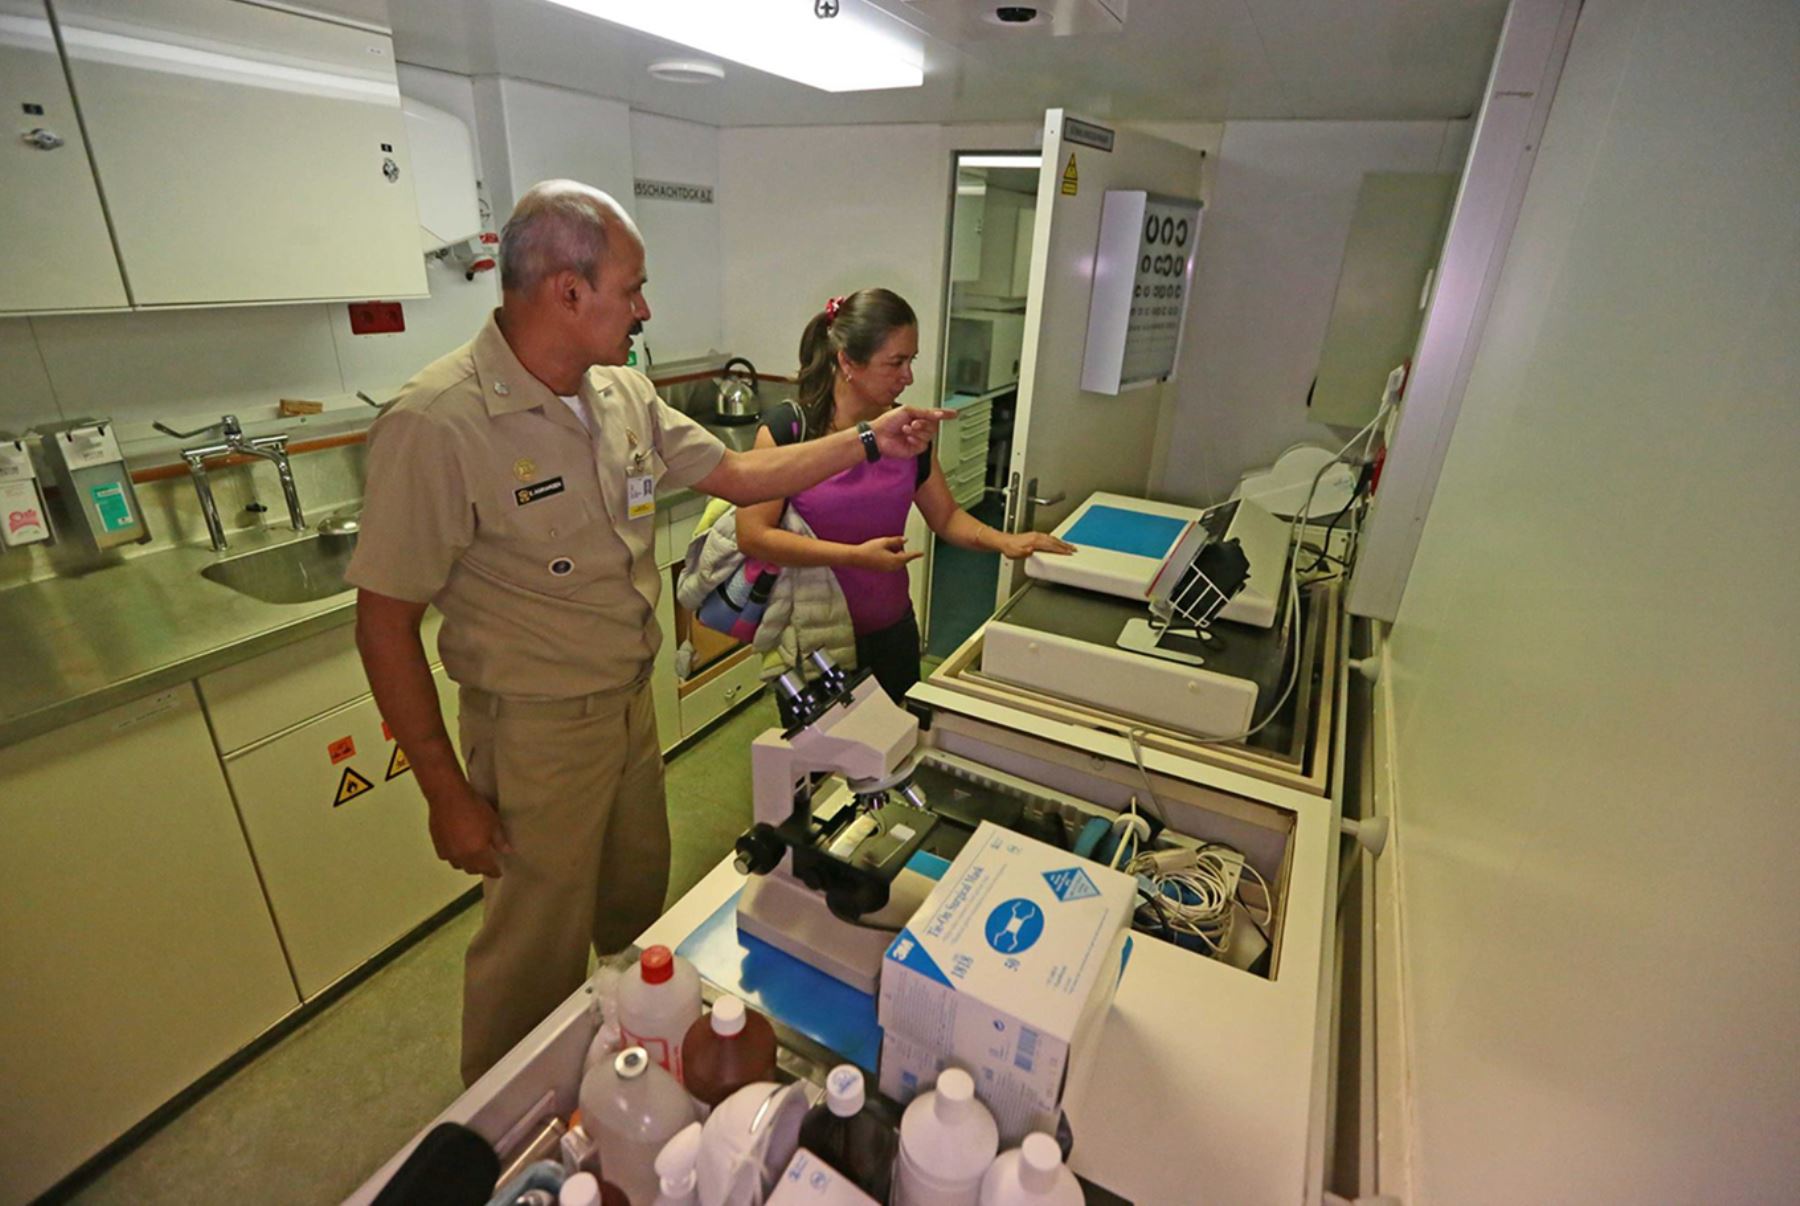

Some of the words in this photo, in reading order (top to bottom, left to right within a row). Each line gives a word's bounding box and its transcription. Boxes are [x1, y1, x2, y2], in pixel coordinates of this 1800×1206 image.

[944, 882, 972, 911] Surgical
[964, 865, 985, 886] Mask
[892, 939, 915, 961] 3M
[951, 955, 974, 979] 1818
